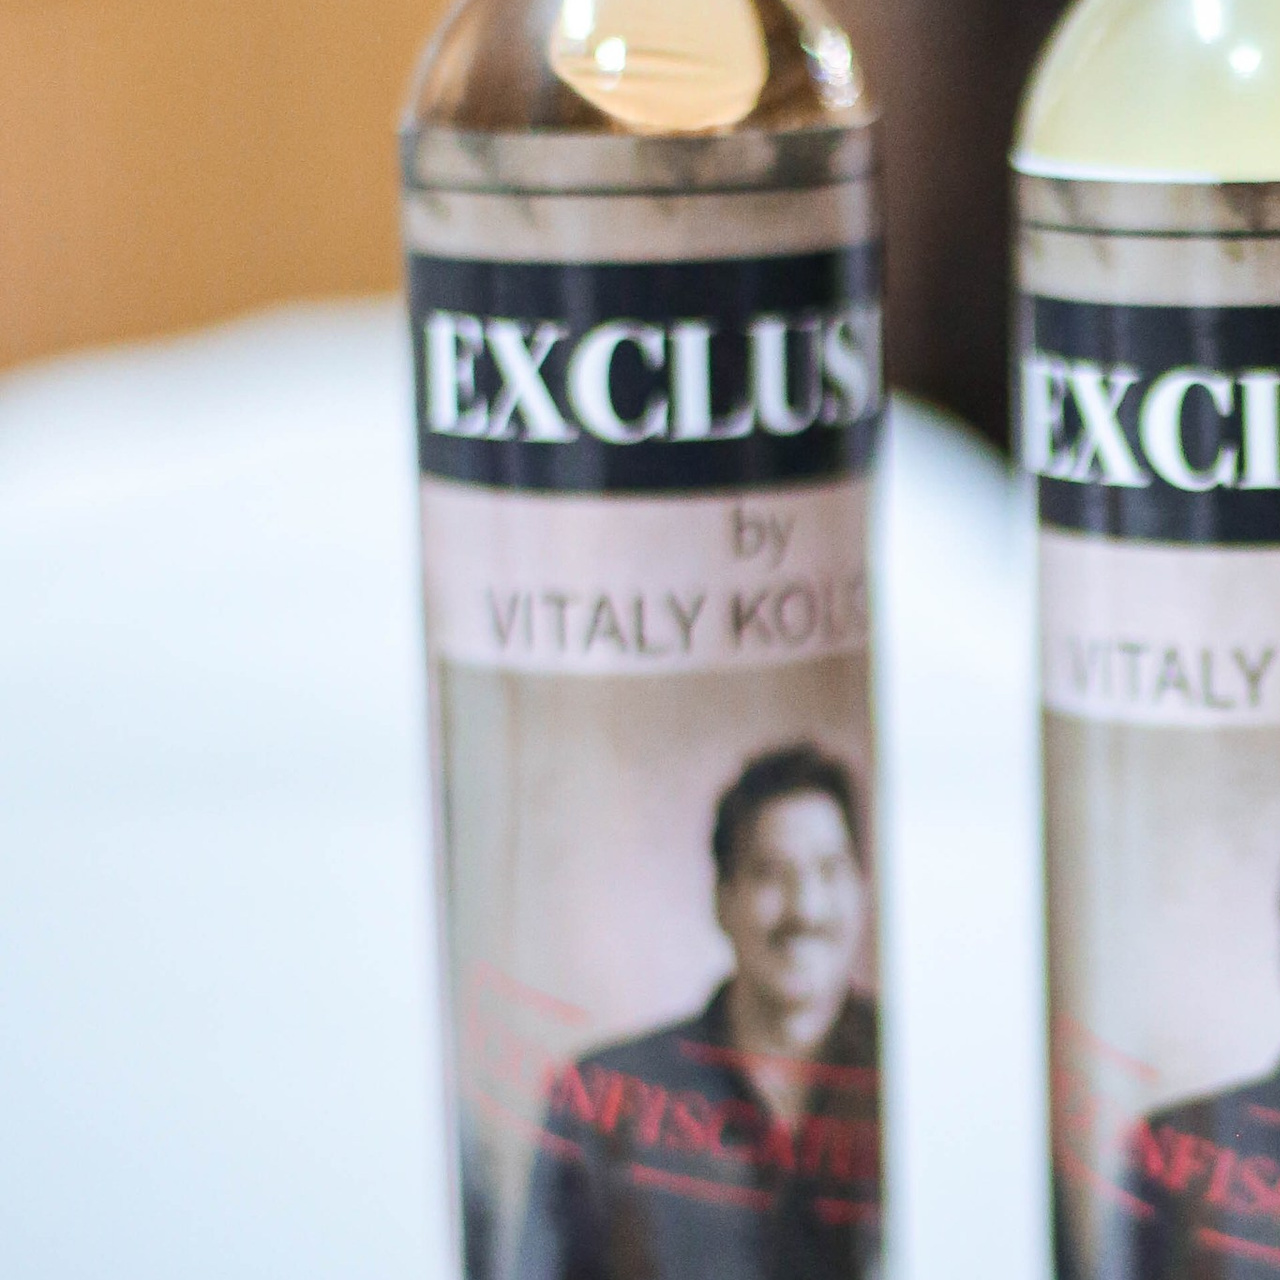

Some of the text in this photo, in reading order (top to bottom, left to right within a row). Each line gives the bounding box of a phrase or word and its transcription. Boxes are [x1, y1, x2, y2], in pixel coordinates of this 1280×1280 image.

[731, 506, 795, 566] by
[486, 586, 706, 657] VITALY
[1062, 635, 1276, 710] VITALY
